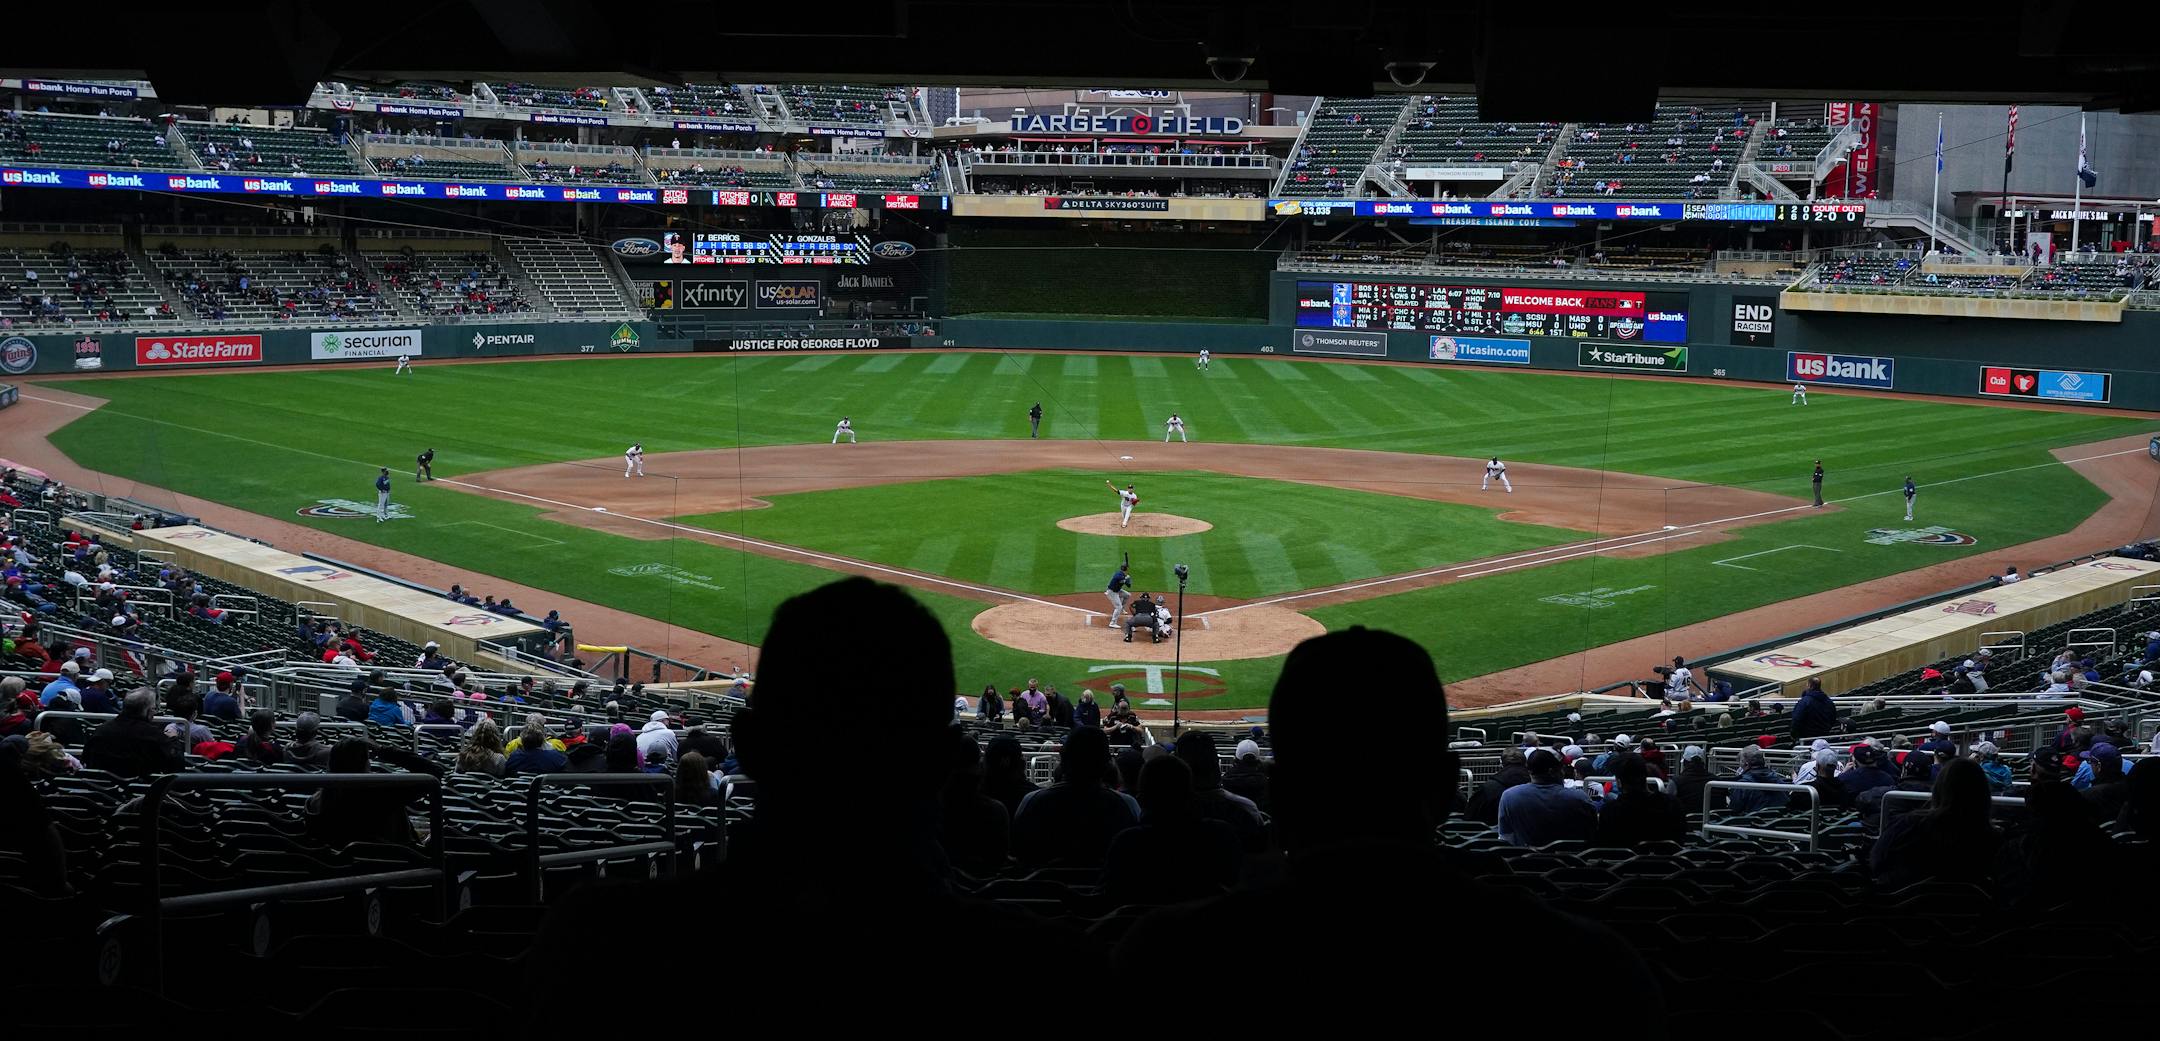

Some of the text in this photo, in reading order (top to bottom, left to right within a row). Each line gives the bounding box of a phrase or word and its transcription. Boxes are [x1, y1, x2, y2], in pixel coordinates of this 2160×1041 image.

[66, 84, 90, 94] Home
[90, 86, 107, 95] Run
[108, 87, 132, 96] Porch
[409, 107, 428, 115] Home
[442, 109, 460, 117] Porch
[1012, 114, 1244, 134] TARGET FIELD
[751, 194, 758, 203] 0
[1303, 207, 1331, 215] $3,035
[2051, 211, 2067, 219] JACK
[1815, 212, 1836, 221] 2-0
[1847, 212, 1855, 221] 0
[838, 274, 894, 288] JACK DANIEL'S
[684, 284, 744, 306] xfinity
[1505, 295, 1553, 306] WELCOME
[1555, 297, 1584, 308] BACK,
[1735, 304, 1772, 320] END
[1737, 322, 1770, 332] RACISM
[344, 335, 412, 350] securian
[487, 335, 534, 345] PENTAIR
[613, 337, 638, 345] SUMMIT
[729, 339, 879, 350] JUSTICE FOR GEORGE FLOYD
[1316, 338, 1348, 346] THOMSON
[1990, 376, 2006, 385] Cub
